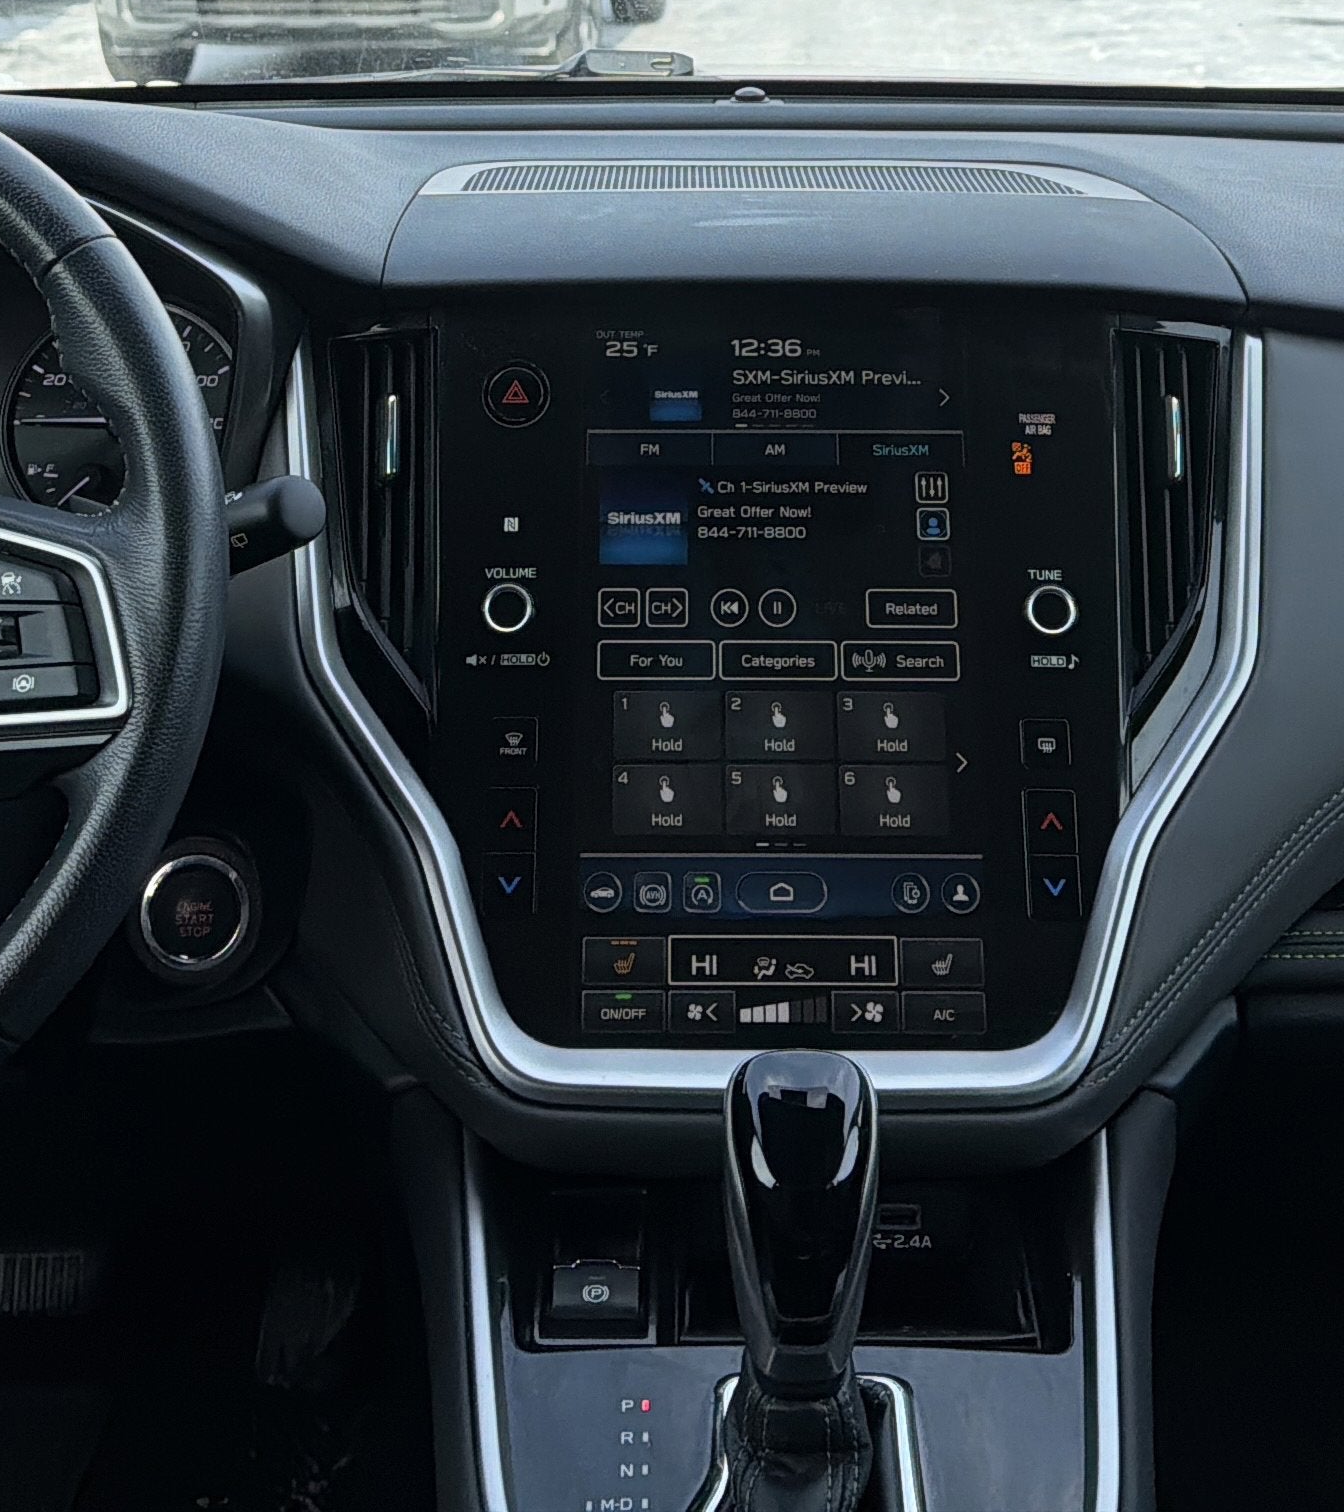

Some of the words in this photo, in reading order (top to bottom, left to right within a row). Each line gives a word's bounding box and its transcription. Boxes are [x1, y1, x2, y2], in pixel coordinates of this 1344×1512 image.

[606, 341, 638, 357] 25
[731, 339, 802, 357] 12:36
[43, 373, 66, 385] 20
[197, 374, 218, 386] 00
[732, 369, 855, 385] SXM-SiriusXM
[654, 390, 698, 399] SiriusXM
[732, 393, 761, 403] Great
[765, 393, 792, 403] Offer
[732, 408, 817, 419] 844-711-8800
[640, 444, 660, 456] FM
[764, 444, 786, 456] AM
[872, 444, 929, 456] SiriusXM
[717, 481, 735, 494] Ch
[740, 481, 810, 494] 1-SiriusXM
[815, 481, 867, 494] Preview
[607, 512, 681, 525] SiriusXM
[697, 506, 735, 518] Great
[740, 506, 774, 518] Offer
[780, 506, 812, 518] Now!
[697, 526, 807, 539] 844-711-8800
[485, 568, 537, 579] VOLUME
[1028, 569, 1062, 580] TUNE
[615, 602, 635, 614] CH
[651, 602, 671, 614] CH
[885, 602, 938, 615] Related
[501, 654, 535, 665] HOLD
[630, 655, 652, 667] For
[659, 655, 683, 667] You
[741, 654, 816, 669] Categories
[896, 655, 944, 668] Search
[1032, 656, 1065, 667] HOLD
[621, 698, 628, 710] 1
[731, 698, 742, 710] 2
[842, 698, 854, 711] 3
[500, 747, 527, 756] FRONT
[652, 739, 683, 752] Hold
[764, 739, 795, 752] Hold
[877, 739, 908, 752] Hold
[618, 772, 629, 785] 4
[731, 772, 742, 784] 5
[844, 772, 856, 785] 6
[651, 813, 683, 826] Hold
[765, 813, 797, 826] Hold
[879, 814, 911, 827] Hold
[175, 914, 214, 925] START
[179, 926, 211, 937] STOP
[691, 955, 717, 976] HI
[851, 955, 877, 976] HI
[600, 1008, 647, 1020] ON/OFF
[933, 1009, 955, 1021] A/C
[894, 1234, 932, 1248] 2.4A
[621, 1399, 634, 1413] P
[620, 1431, 634, 1445] R
[620, 1464, 634, 1478] N
[600, 1497, 633, 1511] M-D
